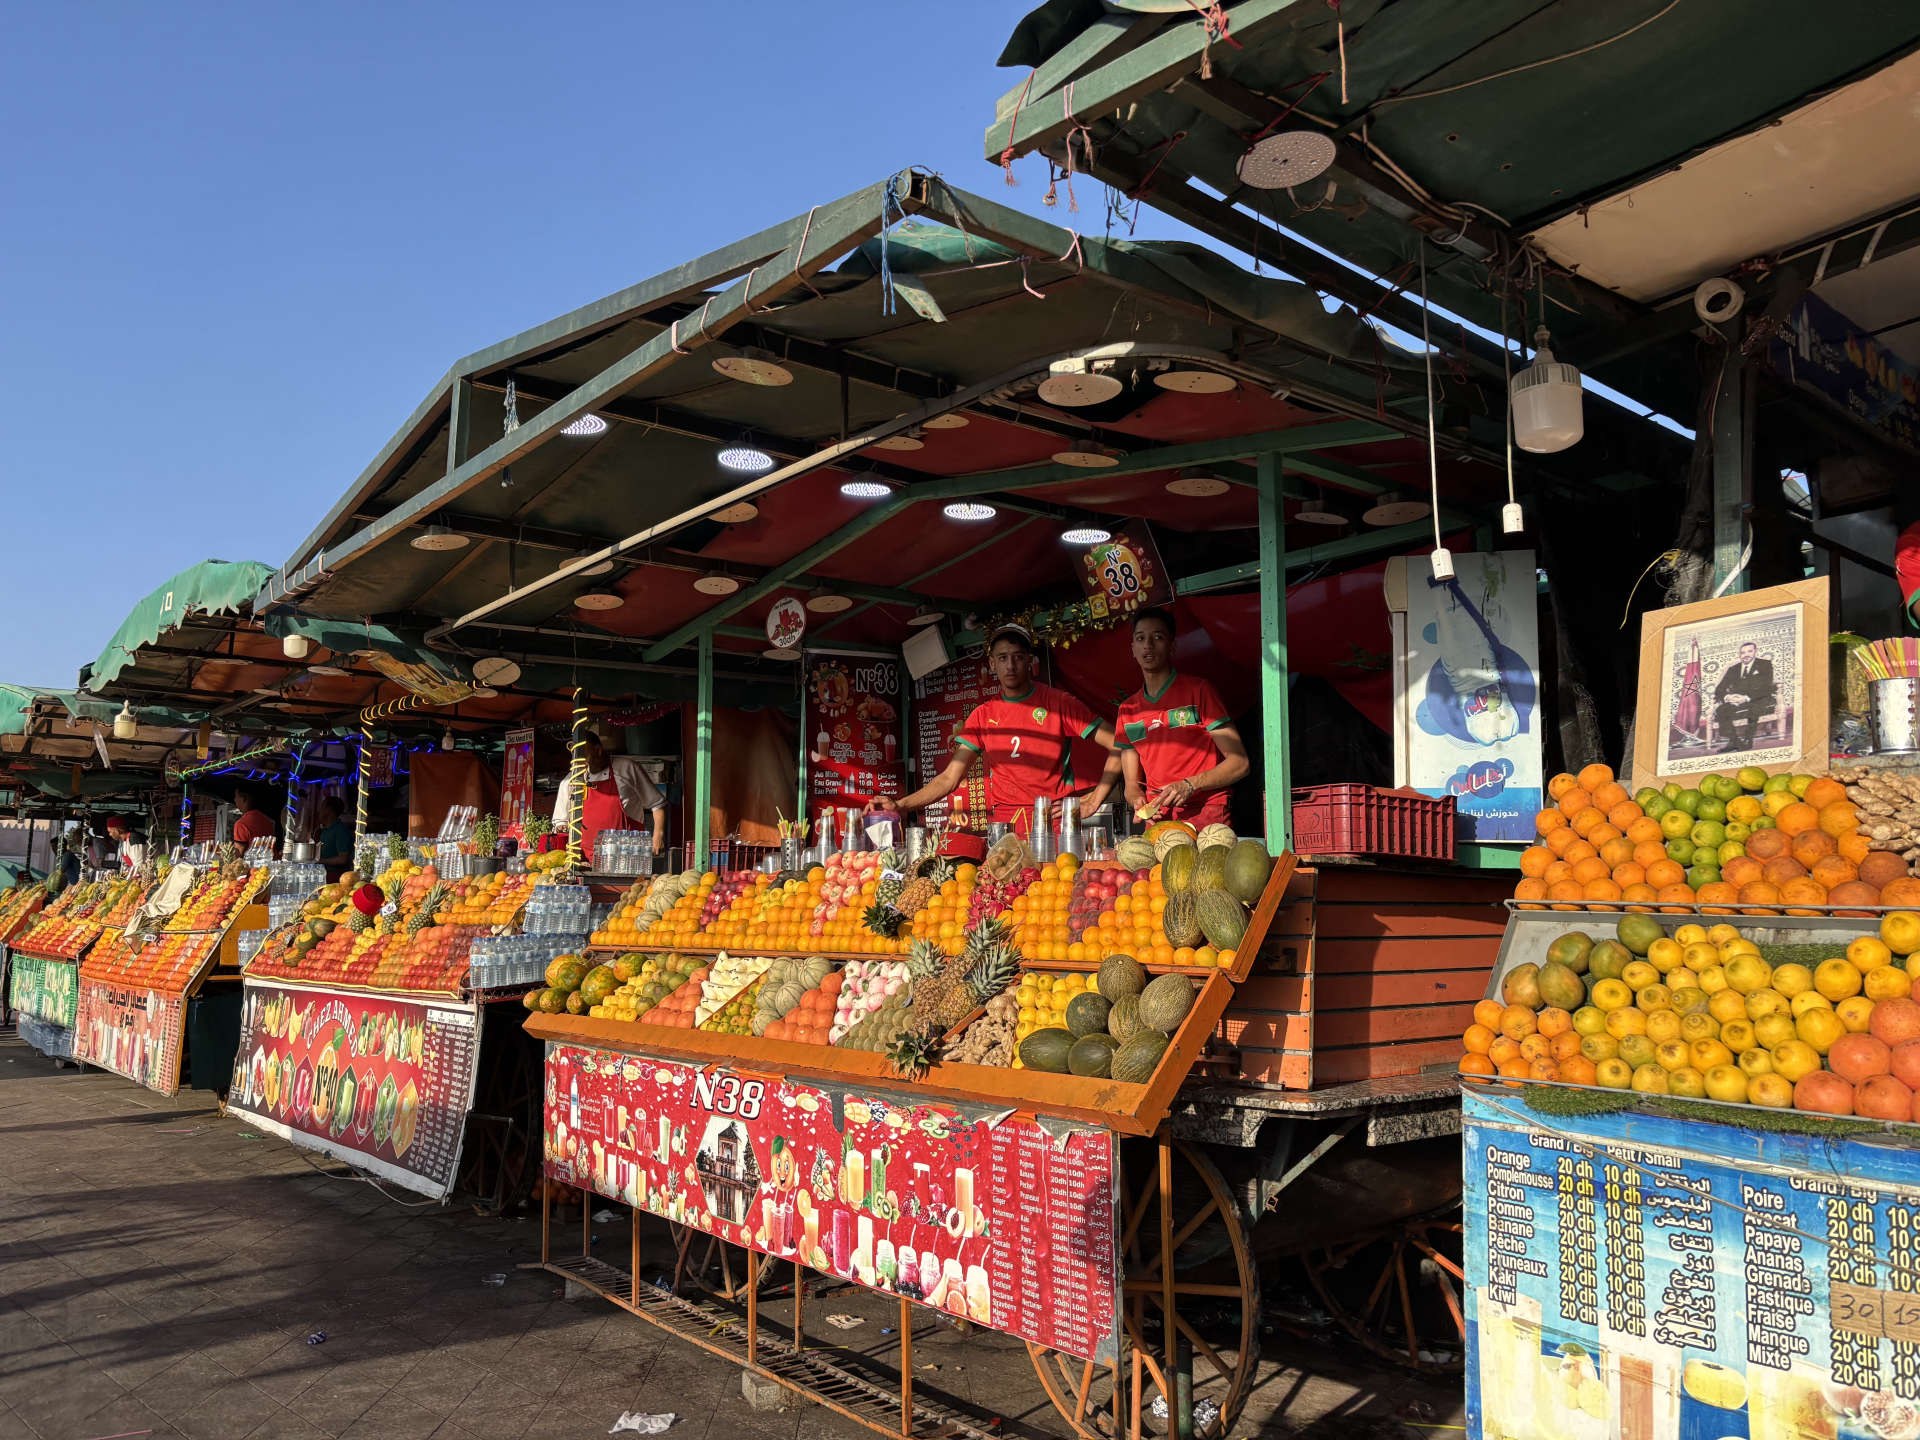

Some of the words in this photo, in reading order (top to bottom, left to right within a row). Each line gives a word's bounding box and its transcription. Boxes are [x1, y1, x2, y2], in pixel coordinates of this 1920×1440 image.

[1104, 562, 1140, 597] 38
[1010, 735, 1021, 758] 2
[306, 1000, 332, 1050] CHEZ
[332, 999, 358, 1058] AHMED
[1528, 1134, 1564, 1151] Grand
[1487, 1146, 1530, 1170] Orange
[1558, 1157, 1574, 1175] 20
[1576, 1161, 1593, 1179] dh
[1604, 1164, 1620, 1183] 10
[1623, 1168, 1641, 1187] dh
[1487, 1163, 1554, 1190] Pomplemousse
[1558, 1175, 1574, 1193] 20
[1576, 1179, 1594, 1197] dh
[1604, 1183, 1620, 1201] 10
[1624, 1187, 1642, 1206] dh
[1488, 1180, 1525, 1202] Citron
[1558, 1193, 1574, 1211] 20
[1577, 1197, 1594, 1215] dh
[1605, 1201, 1621, 1220] 10
[1624, 1206, 1642, 1224] dh
[1488, 1197, 1534, 1220] Pomme
[1559, 1211, 1575, 1229] 20
[1578, 1215, 1594, 1233] dh
[1605, 1219, 1621, 1238] 10
[1624, 1224, 1643, 1242] dh
[1743, 1186, 1784, 1210] Poire
[1828, 1199, 1848, 1220] 20
[1852, 1203, 1873, 1224] dh
[1888, 1208, 1908, 1228] 10
[1488, 1214, 1534, 1238] Banane
[1559, 1229, 1575, 1247] 20
[1578, 1233, 1595, 1251] dh
[1606, 1238, 1622, 1256] 10
[1625, 1242, 1643, 1261] dh
[1488, 1231, 1526, 1254] Pêche
[1559, 1247, 1575, 1265] 20
[1578, 1251, 1596, 1269] dh
[1606, 1256, 1622, 1274] 10
[1626, 1261, 1644, 1280] dh
[1744, 1226, 1801, 1252] Papaye
[1890, 1250, 1909, 1270] 10
[1829, 1220, 1849, 1240] 20
[1853, 1224, 1874, 1245] dh
[1889, 1229, 1908, 1249] 10
[1488, 1248, 1548, 1278] Pruneaux
[1559, 1265, 1576, 1283] 20
[1579, 1269, 1596, 1287] dh
[1606, 1274, 1622, 1293] 10
[1626, 1280, 1644, 1298] dh
[1745, 1245, 1804, 1272] Ananas
[1830, 1260, 1850, 1281] 20
[1854, 1265, 1876, 1286] dh
[1890, 1271, 1910, 1291] 10
[1746, 1264, 1811, 1294] Grenade
[1488, 1266, 1516, 1288] Kaki
[1560, 1283, 1576, 1301] 20
[1580, 1288, 1596, 1306] dh
[1607, 1293, 1623, 1311] 10
[1626, 1298, 1645, 1316] dh
[1488, 1283, 1516, 1306] Kiwi
[1560, 1301, 1576, 1319] 20
[1580, 1306, 1597, 1324] dh
[1607, 1311, 1623, 1329] 10
[1627, 1316, 1645, 1335] dh
[1746, 1284, 1814, 1316] Pastique
[1839, 1293, 1874, 1320] 30
[1892, 1303, 1920, 1326] 15
[1747, 1304, 1796, 1330] Fraise
[1748, 1324, 1809, 1354] Mangue
[1832, 1342, 1852, 1363] 20
[1857, 1347, 1879, 1368] dh
[1893, 1355, 1913, 1375] 10
[1748, 1343, 1791, 1370] Mixte
[1833, 1363, 1853, 1384] 20
[1858, 1367, 1880, 1388] dh
[1894, 1376, 1914, 1396] 10
